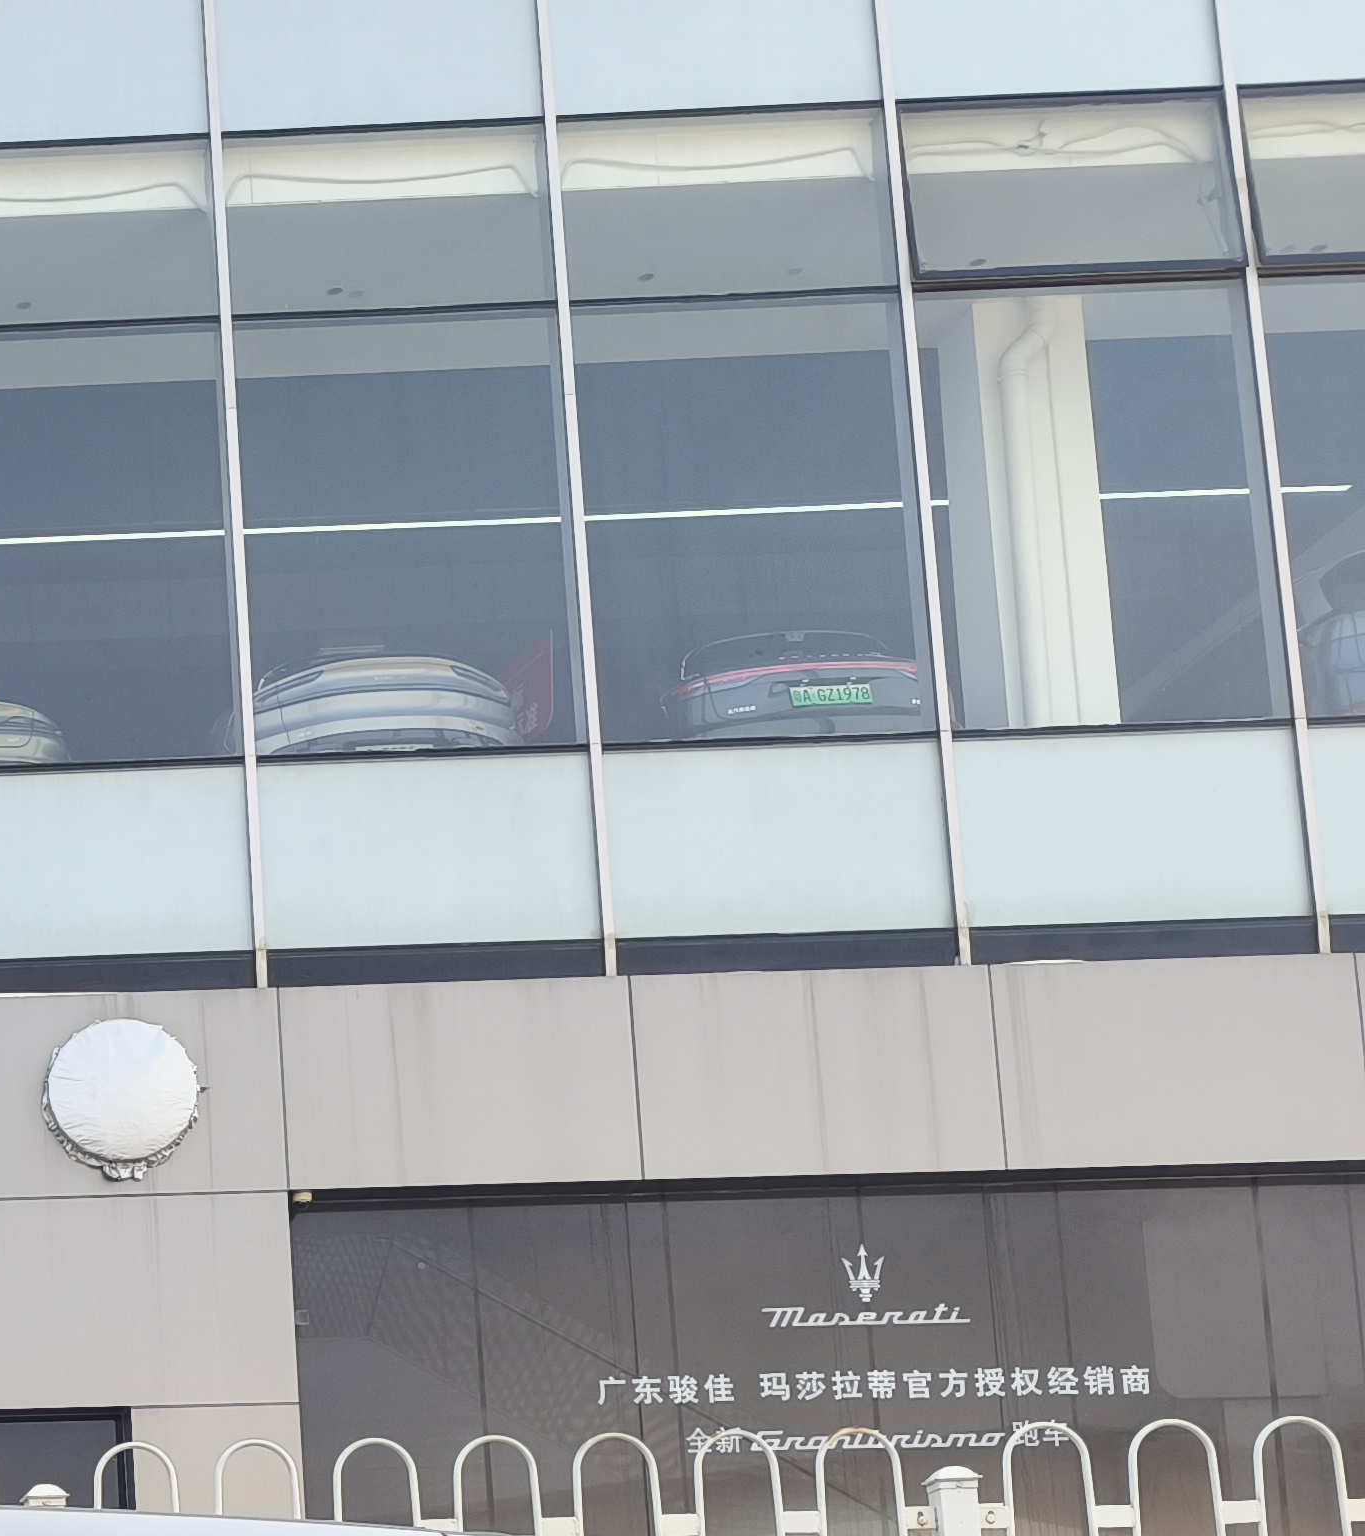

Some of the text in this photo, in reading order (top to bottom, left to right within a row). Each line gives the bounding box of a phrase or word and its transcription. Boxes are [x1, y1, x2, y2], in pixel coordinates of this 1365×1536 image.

[761, 1303, 971, 1329] Maserati
[597, 1364, 1152, 1406] 广东骏佳 玛莎拉蒂官方授权经销商
[685, 1426, 743, 1454] 全新
[1012, 1419, 1069, 1447] 跑车
